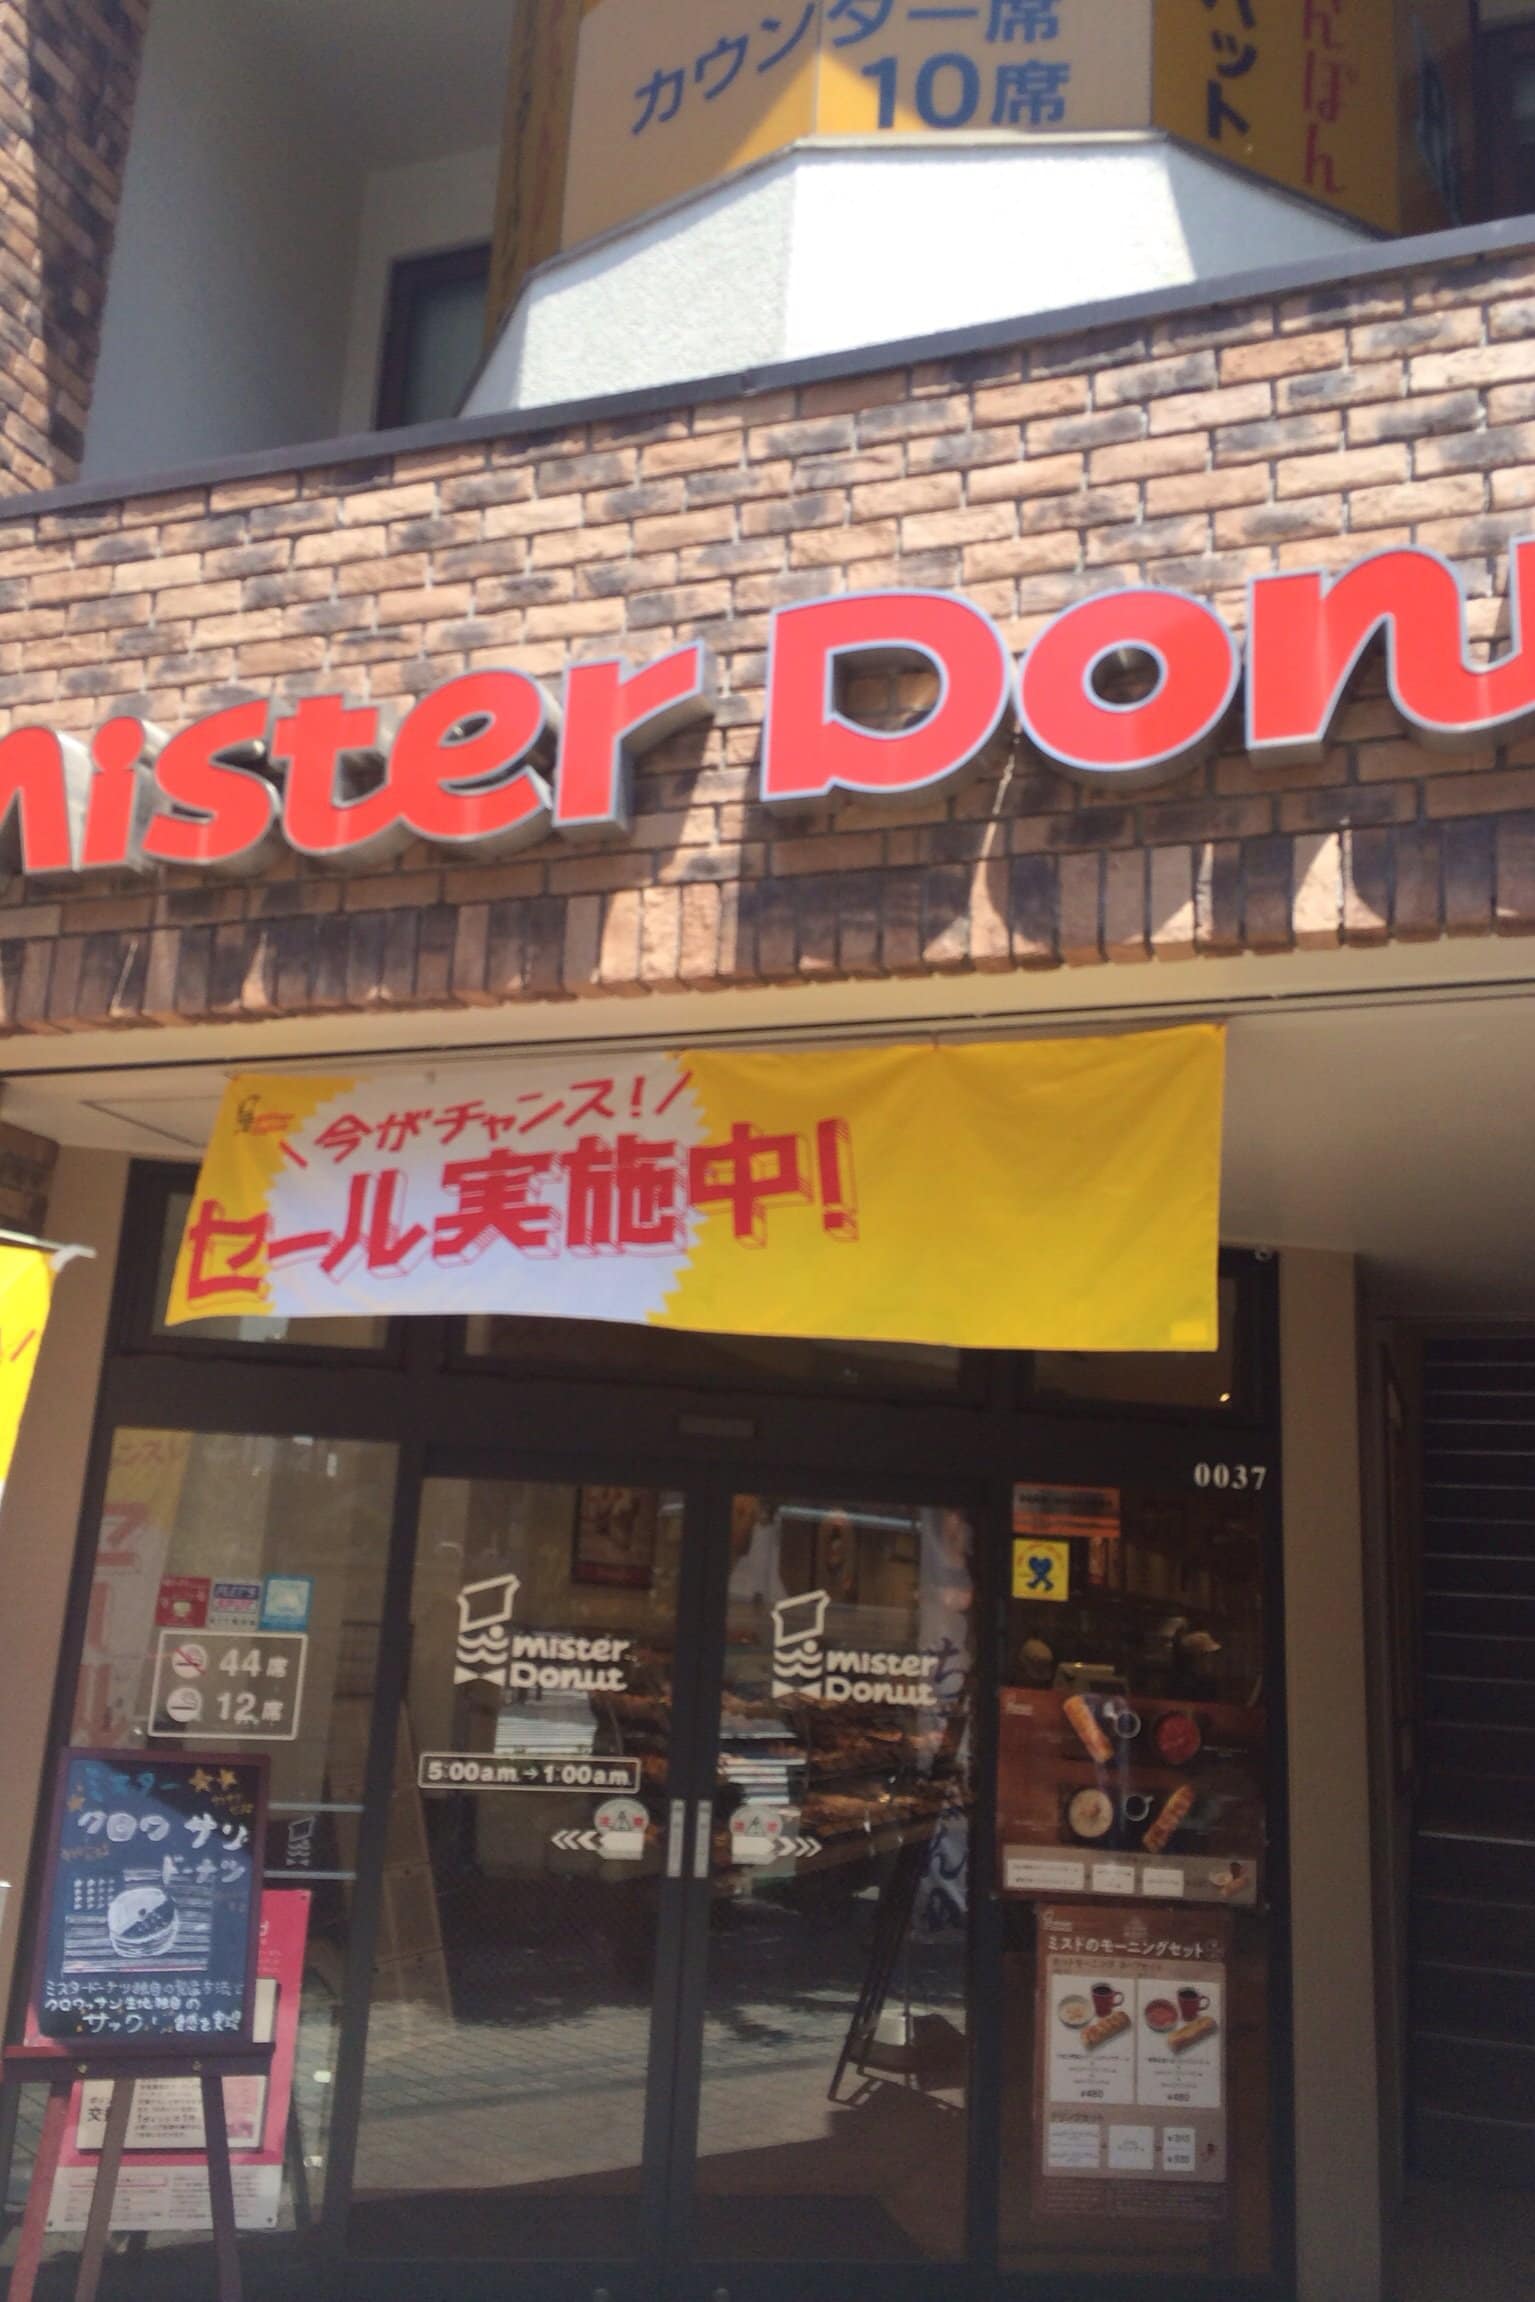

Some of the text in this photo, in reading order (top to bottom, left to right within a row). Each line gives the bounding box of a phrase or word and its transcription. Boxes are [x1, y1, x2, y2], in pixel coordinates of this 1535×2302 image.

[858, 52, 1072, 131] 10席
[185, 1116, 860, 1308] セール実施中!
[1193, 1462, 1268, 1491] 0037
[509, 1661, 628, 1692] Donut
[825, 1675, 938, 1706] Donut
[1047, 1935, 1204, 1960] ミストのモーニングセット
